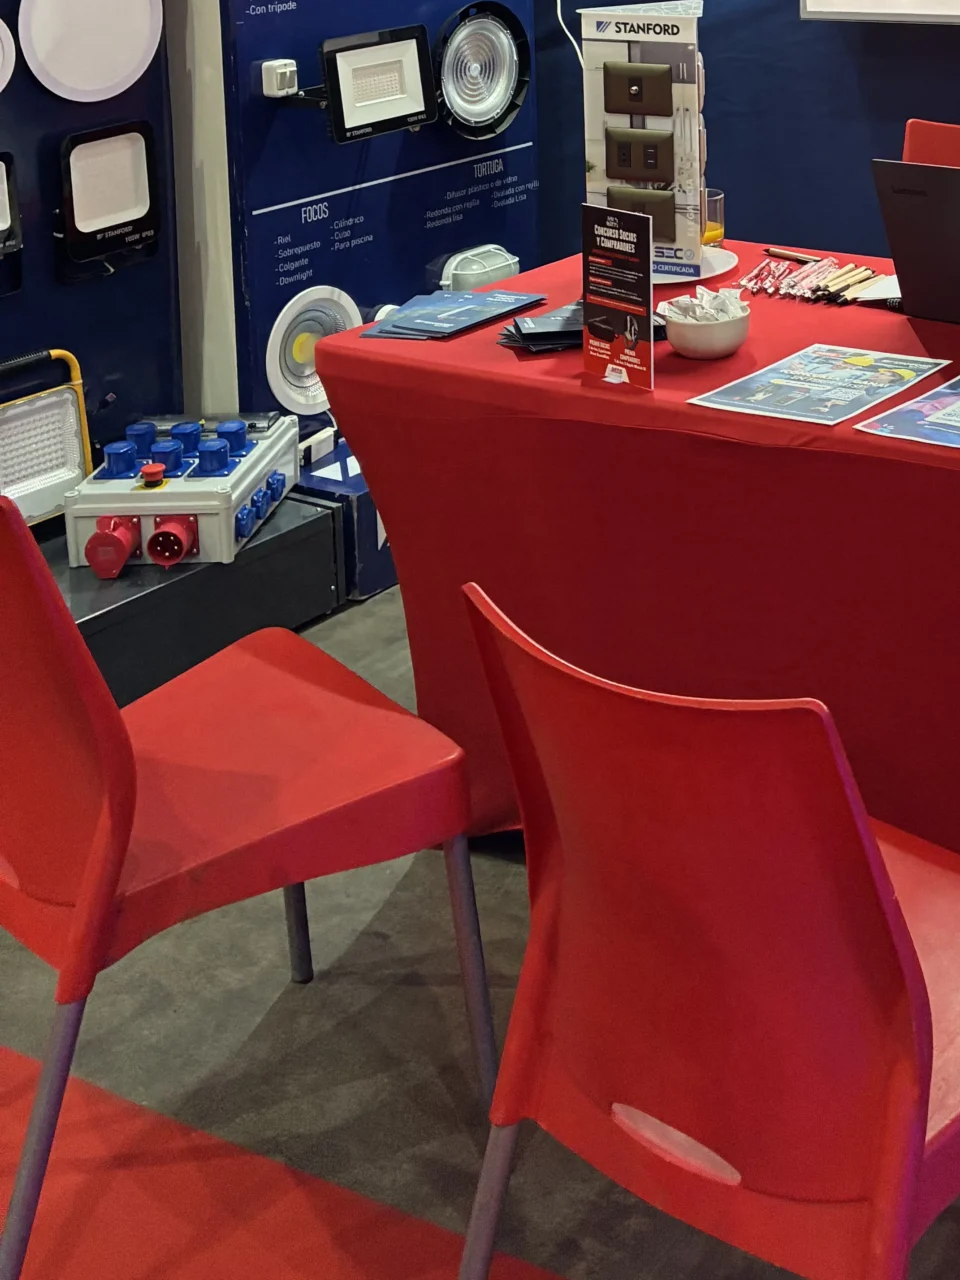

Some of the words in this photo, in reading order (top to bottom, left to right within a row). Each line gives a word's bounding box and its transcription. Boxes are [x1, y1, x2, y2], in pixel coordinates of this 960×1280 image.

[268, 1, 297, 13] trípode
[615, 21, 680, 36] STANFORD
[474, 159, 503, 178] TORTUGA
[301, 202, 329, 223] FOCOS
[351, 235, 373, 248] piscina
[654, 246, 683, 259] SEC
[658, 265, 694, 273] CERTIFICADA
